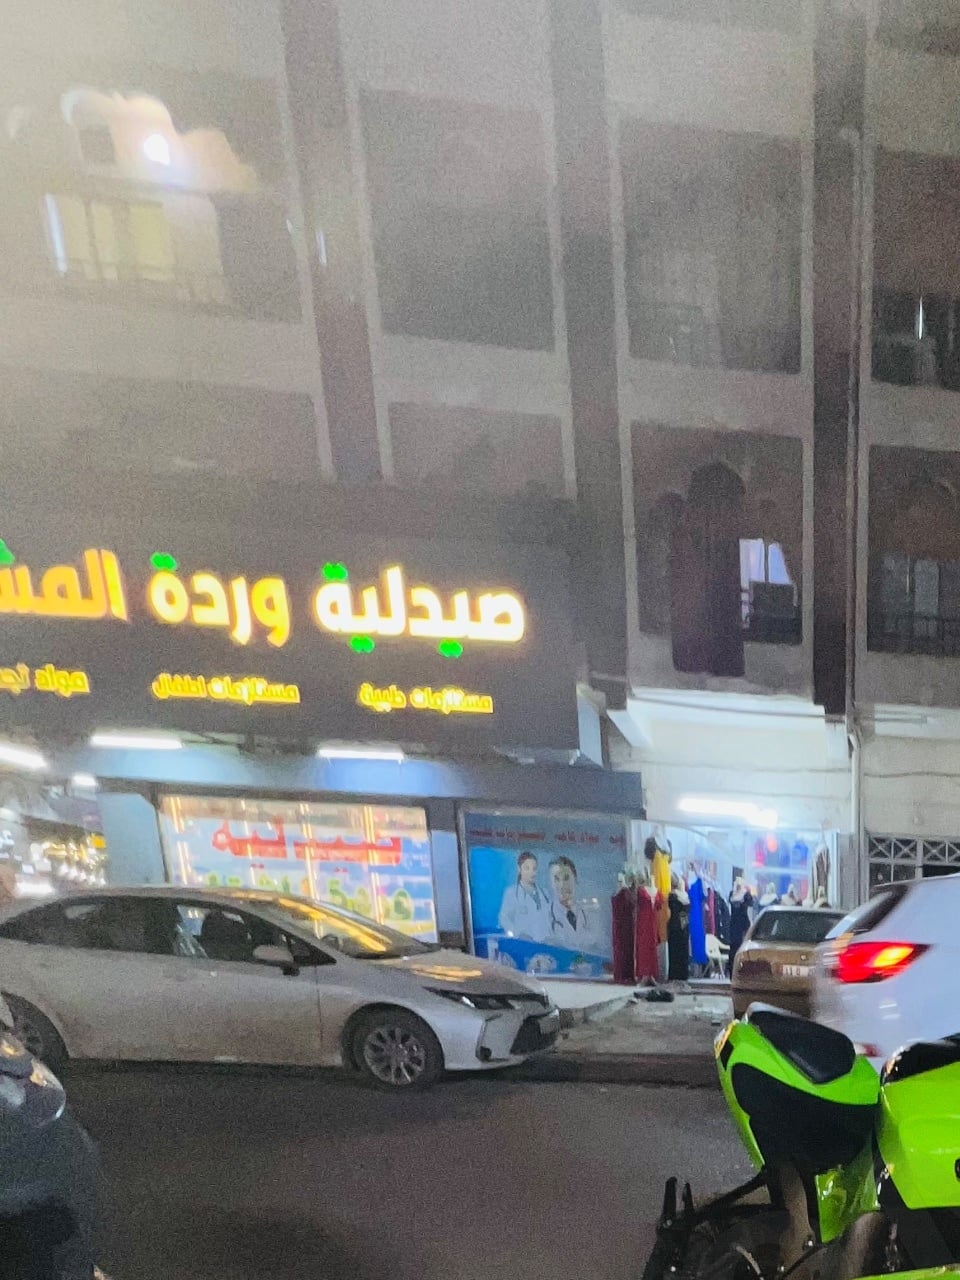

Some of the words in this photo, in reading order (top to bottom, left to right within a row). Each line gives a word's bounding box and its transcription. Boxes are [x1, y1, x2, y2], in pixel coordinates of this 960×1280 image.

[150, 552, 290, 648] وردة
[315, 561, 525, 658] صيدلية
[35, 664, 90, 697] مواد
[207, 675, 301, 705] مستلزمات
[359, 682, 407, 712] طبية
[409, 686, 494, 714] مستلزمات
